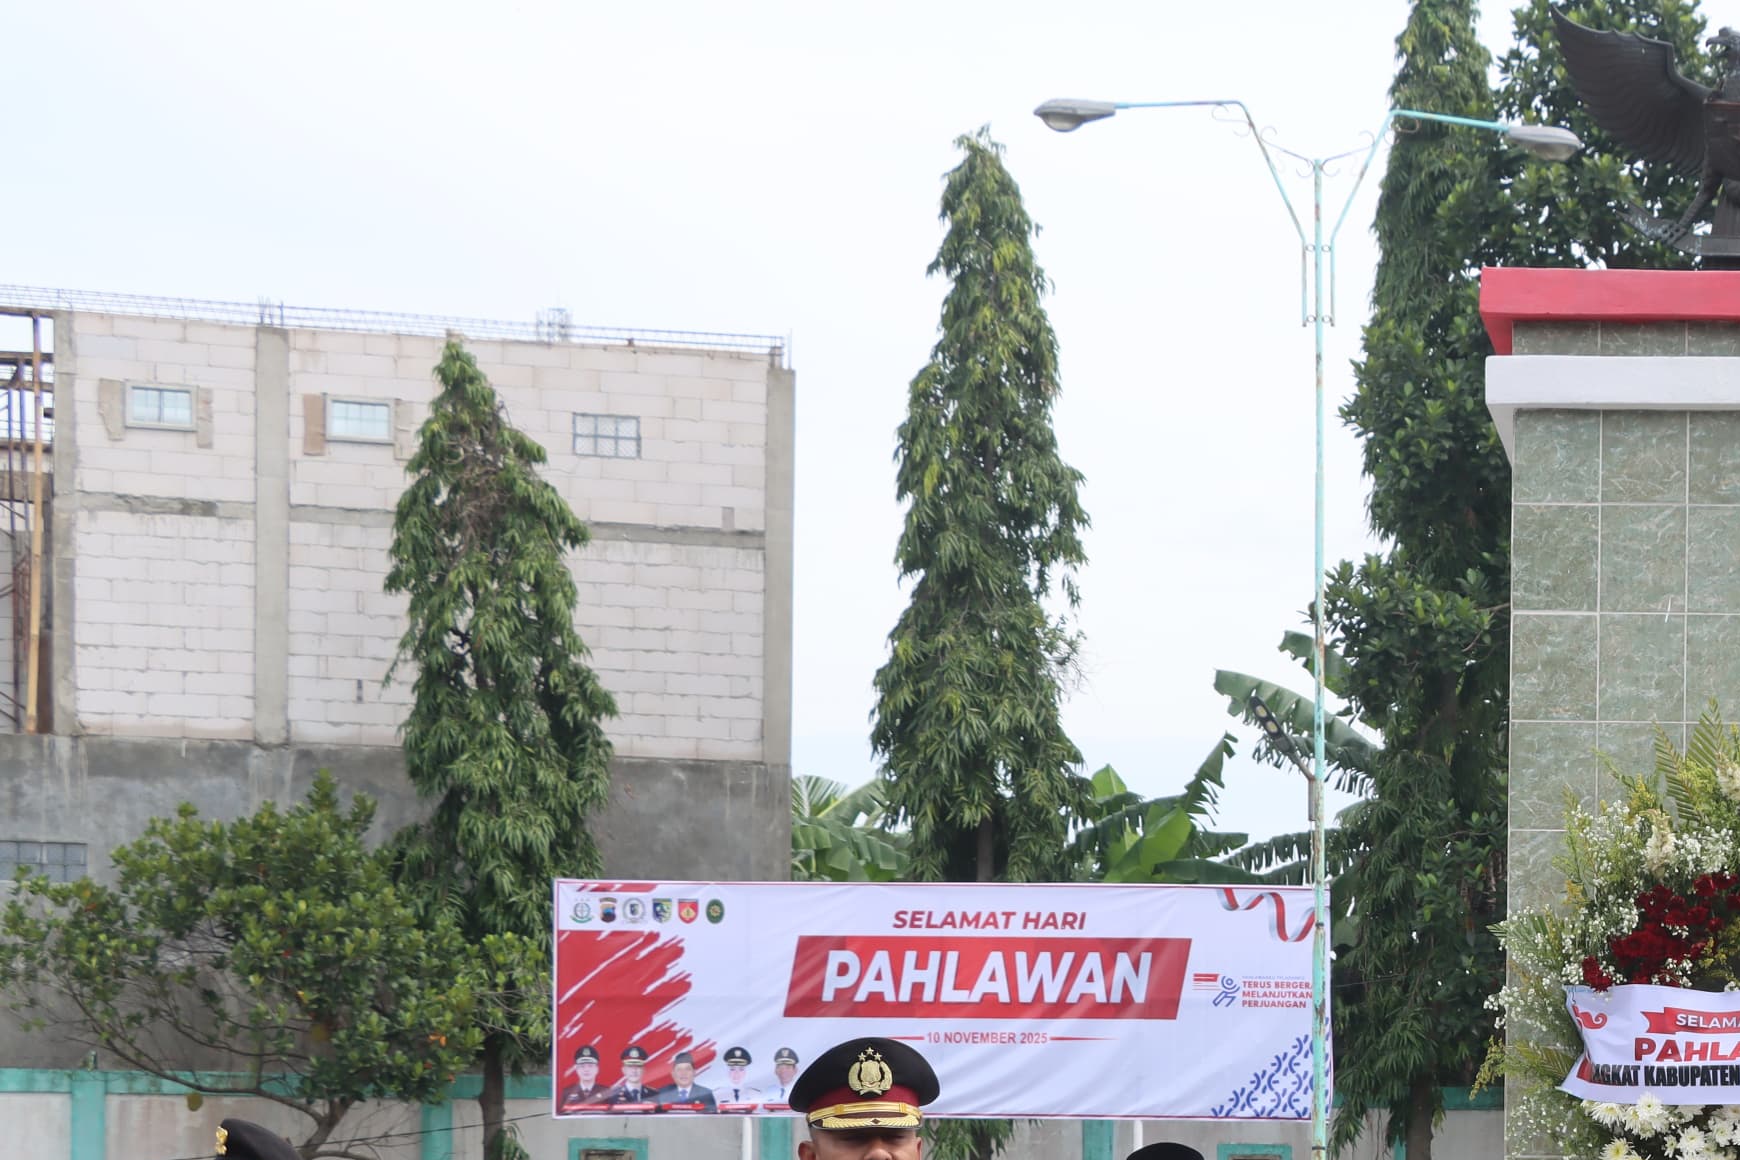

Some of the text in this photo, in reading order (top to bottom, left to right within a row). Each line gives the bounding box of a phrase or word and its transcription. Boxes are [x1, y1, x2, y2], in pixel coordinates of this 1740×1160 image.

[893, 910, 1087, 931] SELAMAT HARI
[821, 950, 1153, 1004] PAHLAWAN
[1242, 980, 1314, 990] TERUS BERGER
[1242, 990, 1313, 999] MELANJUTKAN
[1242, 999, 1307, 1009] PERJUANGAN
[927, 1032, 1048, 1044] 10 NOVEMBER 2025
[1643, 1063, 1740, 1087] KABUPATEN
